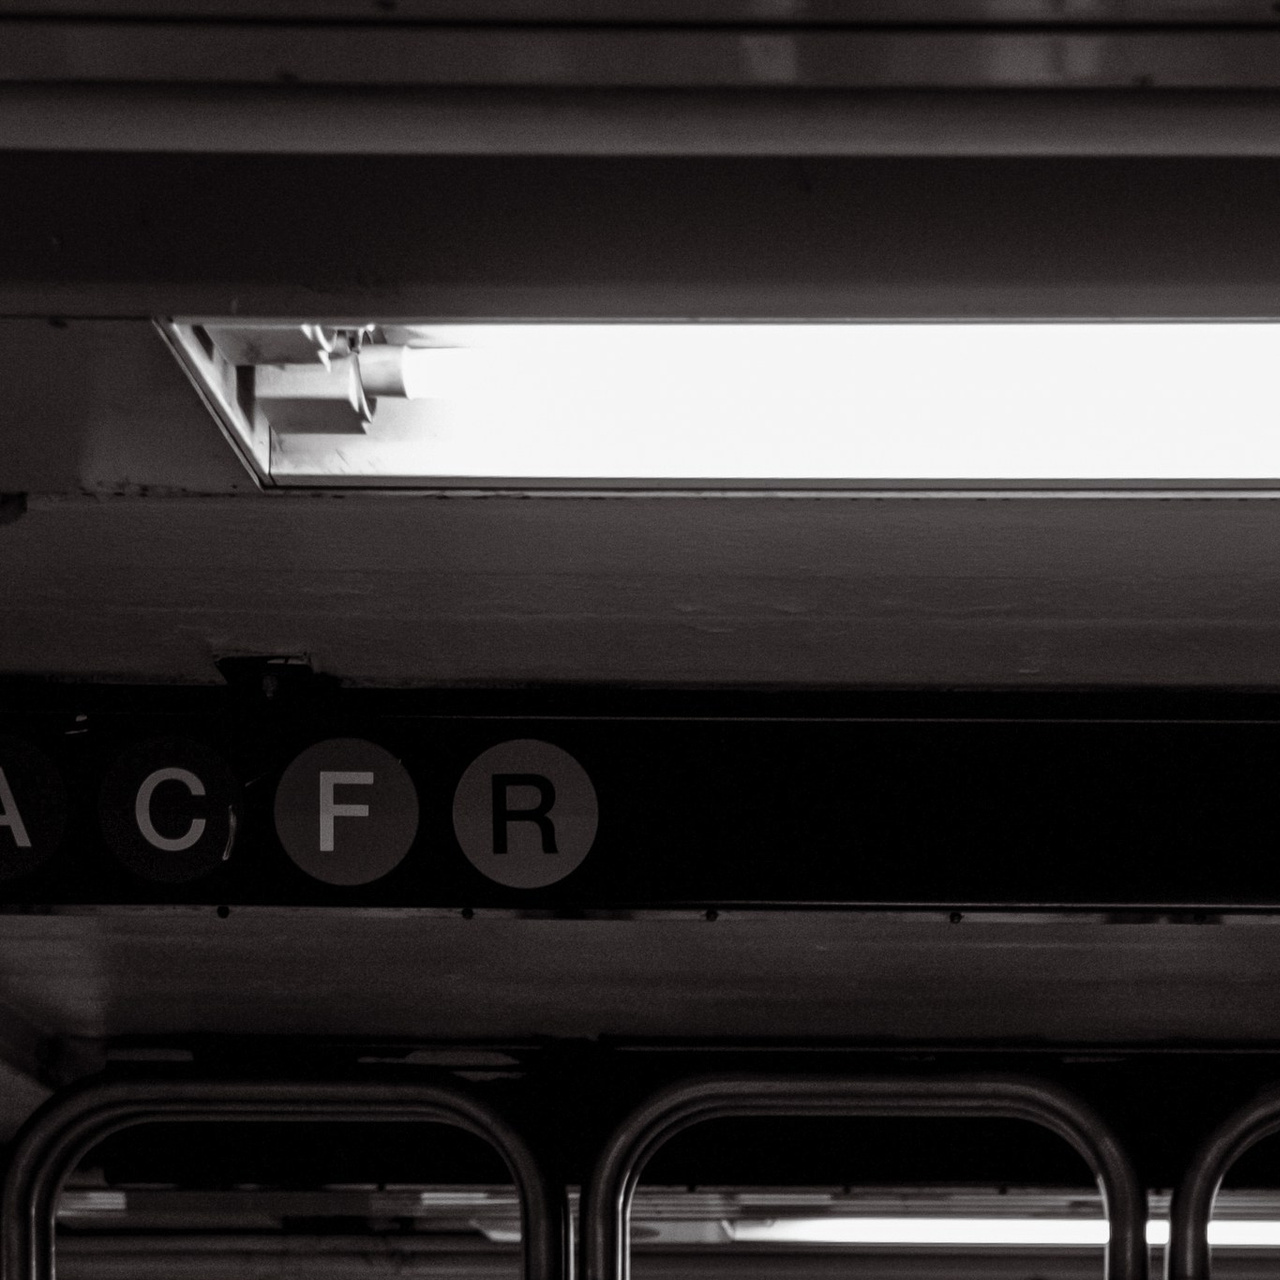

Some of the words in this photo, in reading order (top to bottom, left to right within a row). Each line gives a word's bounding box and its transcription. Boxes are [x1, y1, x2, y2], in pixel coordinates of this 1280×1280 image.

[135, 766, 207, 852] C
[318, 770, 375, 852] F
[492, 774, 559, 854] R
